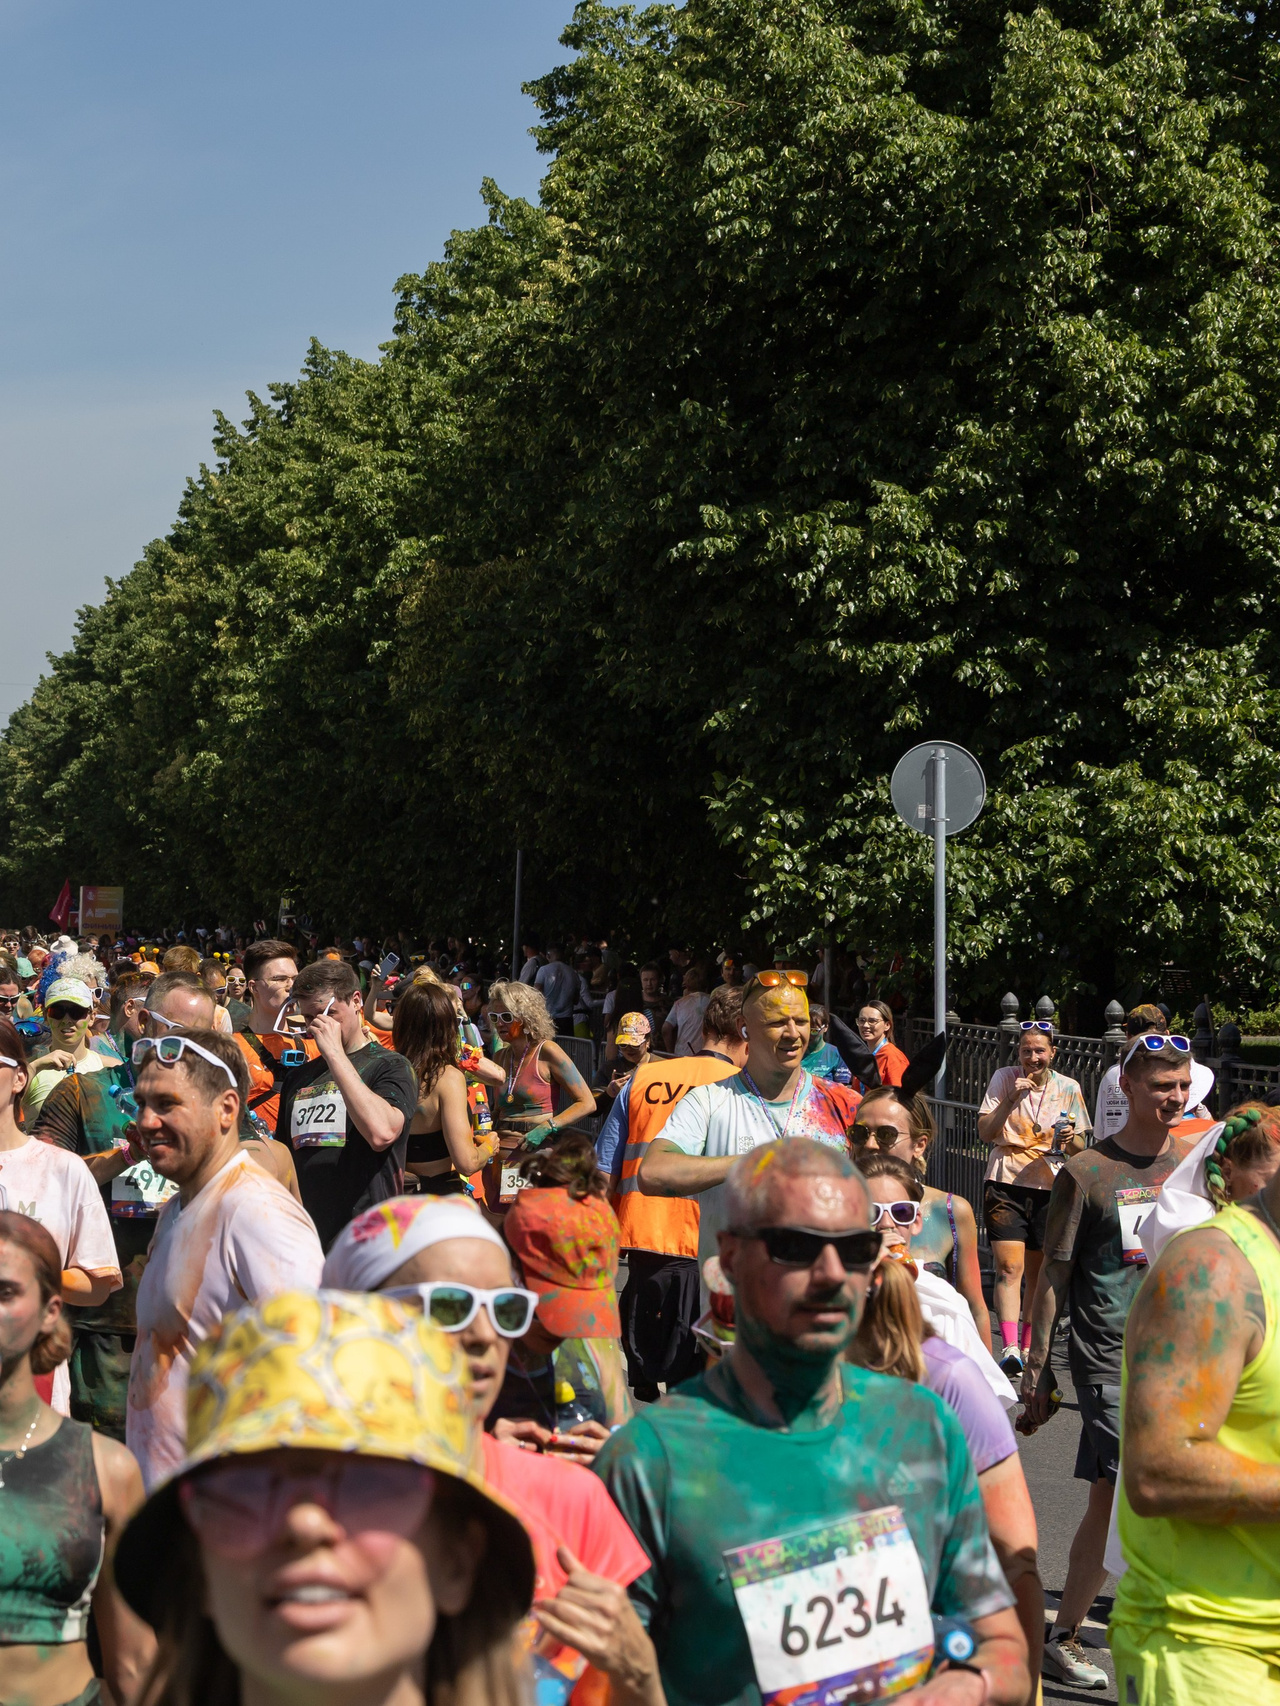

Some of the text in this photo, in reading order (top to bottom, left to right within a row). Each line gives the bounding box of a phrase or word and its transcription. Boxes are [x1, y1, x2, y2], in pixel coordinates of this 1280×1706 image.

[82, 922, 120, 930] ФИНИШ
[296, 1103, 336, 1127] 3722
[780, 1576, 906, 1657] 6234
